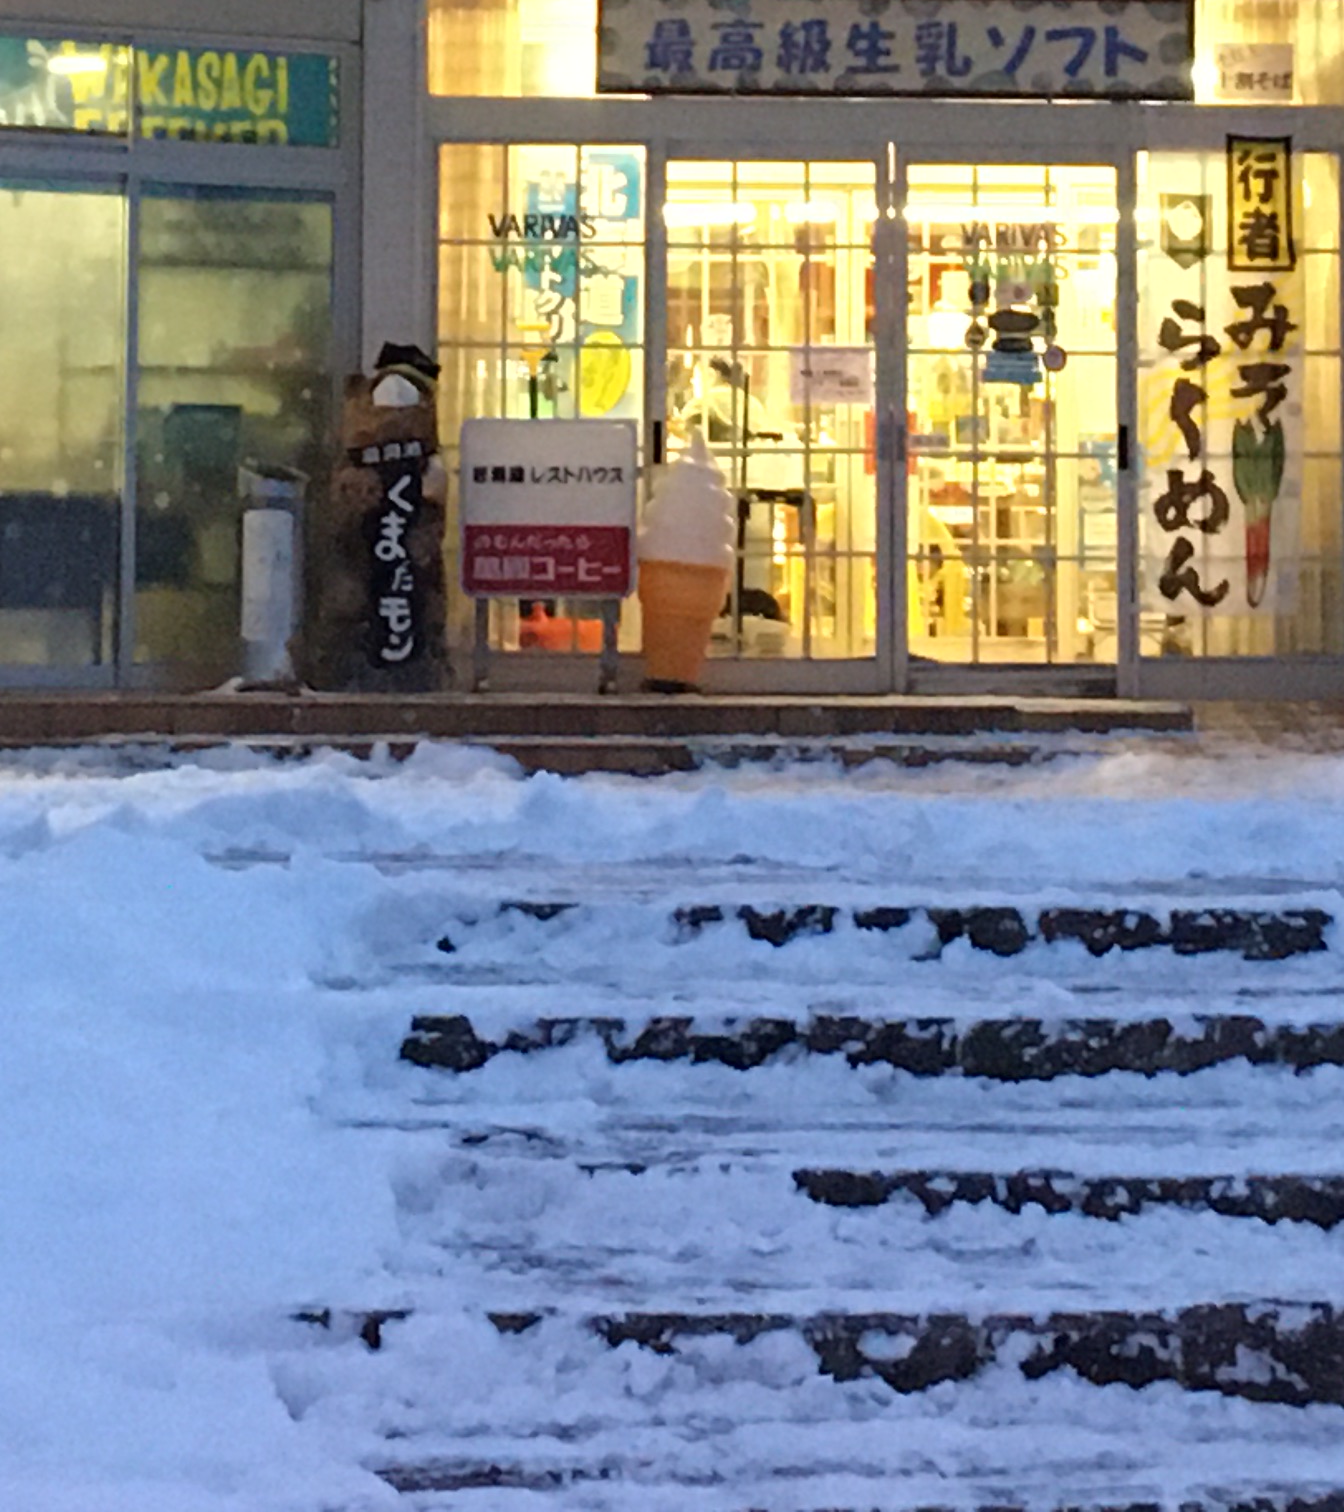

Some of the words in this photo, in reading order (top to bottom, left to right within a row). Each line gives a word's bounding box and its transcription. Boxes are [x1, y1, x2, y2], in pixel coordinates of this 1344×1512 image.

[643, 19, 1148, 77] 最高級生乳ソフト
[487, 213, 597, 240] VARIVAS
[1236, 149, 1280, 262] 行者
